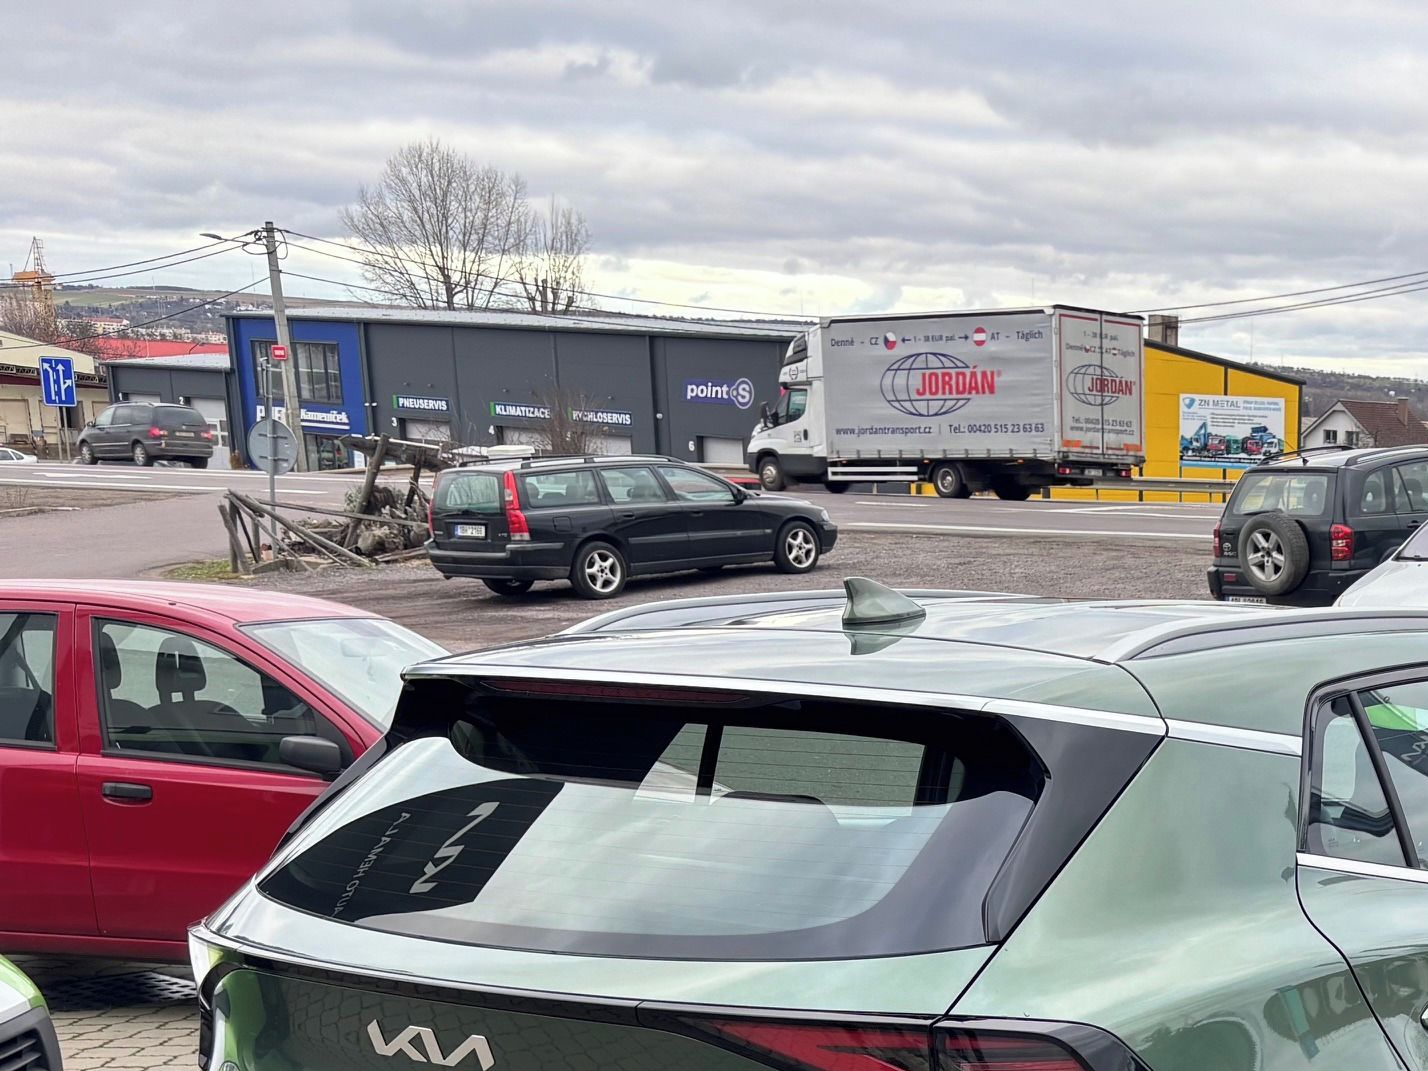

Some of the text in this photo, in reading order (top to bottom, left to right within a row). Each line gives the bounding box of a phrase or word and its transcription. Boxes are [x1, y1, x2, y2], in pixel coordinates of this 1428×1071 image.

[830, 337, 855, 347] Denně
[869, 336, 880, 346] CZ
[990, 332, 1000, 341] AT
[686, 382, 730, 400] point
[398, 397, 448, 411] PNEUSERVIS
[1198, 399, 1210, 407] ZN
[1212, 400, 1241, 409] METAL
[495, 404, 551, 419] KLIMATIZACE
[836, 425, 932, 438] www.jordantransport.cz
[967, 424, 992, 434] 00420
[993, 424, 1009, 433] 515
[1011, 424, 1021, 433] 23
[1022, 423, 1033, 433] 63
[1034, 423, 1045, 433] 63
[688, 441, 695, 452] 6
